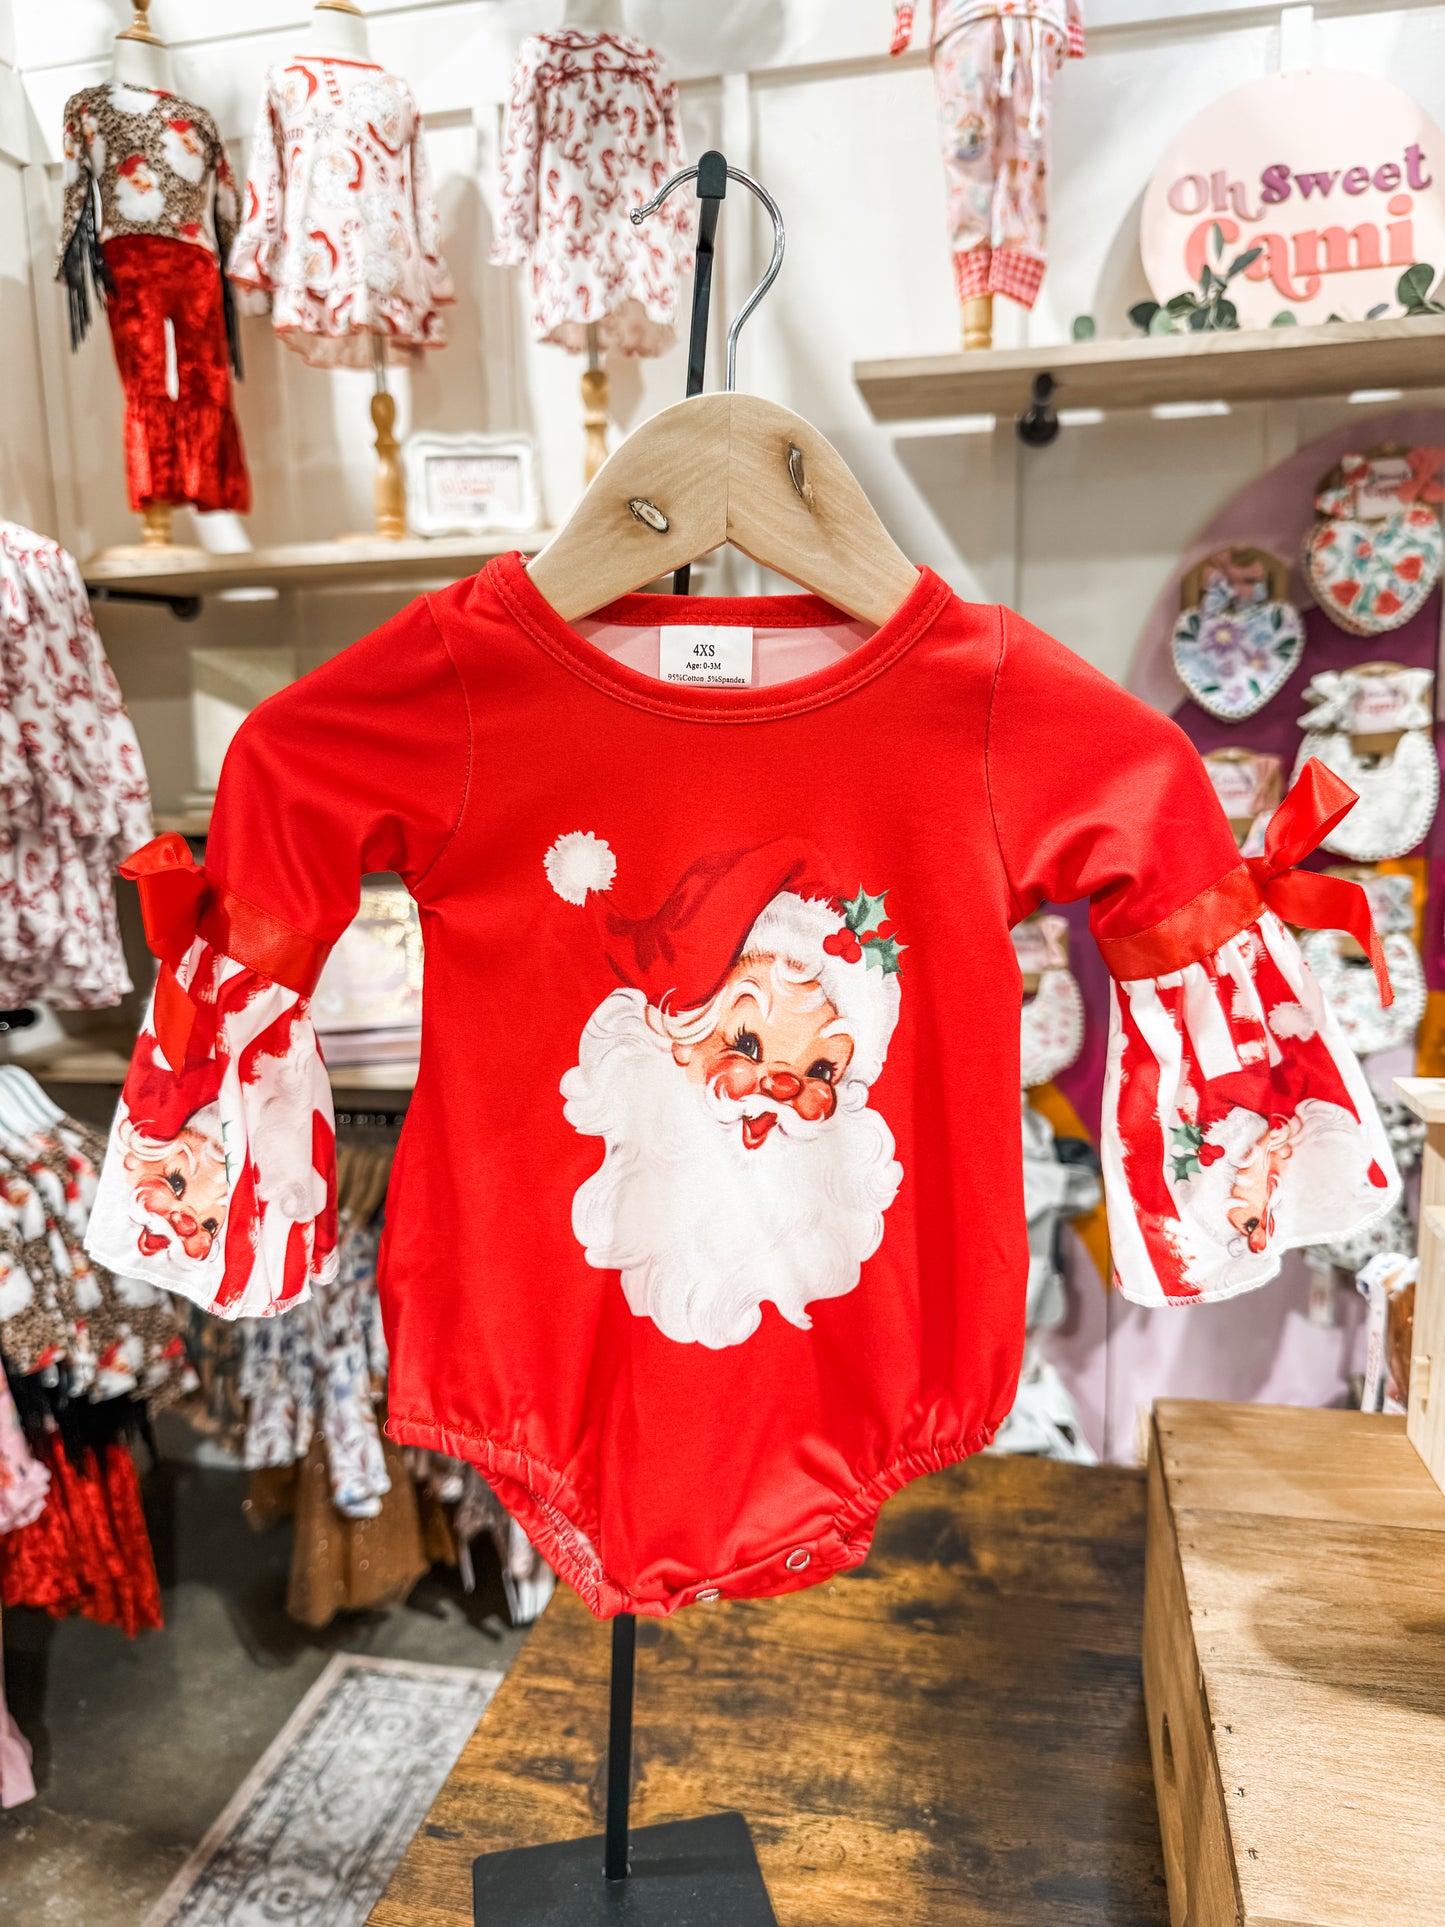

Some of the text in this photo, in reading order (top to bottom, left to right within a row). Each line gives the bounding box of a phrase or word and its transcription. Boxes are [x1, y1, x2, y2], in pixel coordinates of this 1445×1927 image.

[1167, 143, 1432, 222] Oh Sweet
[1184, 194, 1417, 302] Cami
[693, 644, 715, 657] 4XS
[686, 662, 721, 670] Age: 0-3M
[667, 673, 745, 684] 95%Cotton 5%Spandex
